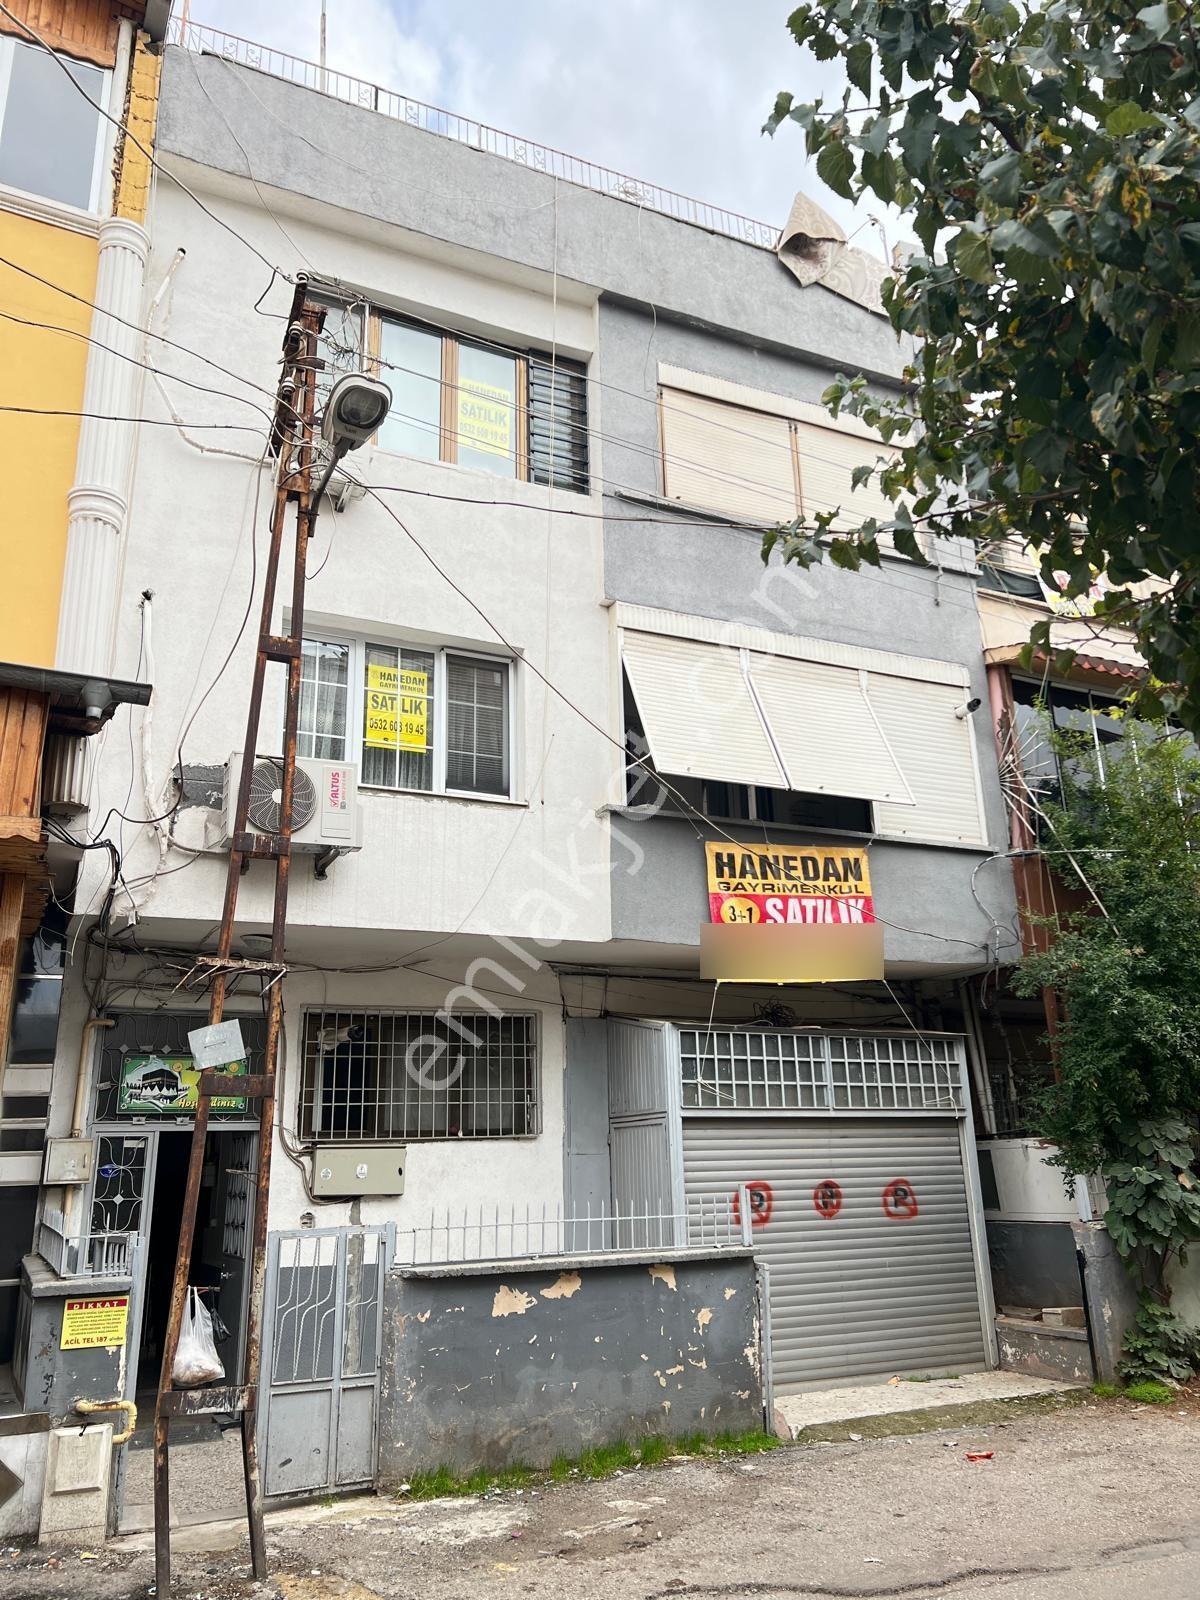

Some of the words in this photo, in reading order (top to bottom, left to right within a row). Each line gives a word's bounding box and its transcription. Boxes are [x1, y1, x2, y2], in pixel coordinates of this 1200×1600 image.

[461, 402, 507, 427] SATILIK
[380, 671, 425, 687] HANEDAN
[371, 693, 423, 716] SATLIK
[369, 717, 388, 731] 0532
[405, 722, 414, 734] 19
[415, 724, 425, 736] 45
[330, 771, 340, 799] ALTUS
[715, 851, 863, 882] HANEDAN
[728, 905, 753, 923] 3+1
[64, 1337, 80, 1345] ACİL
